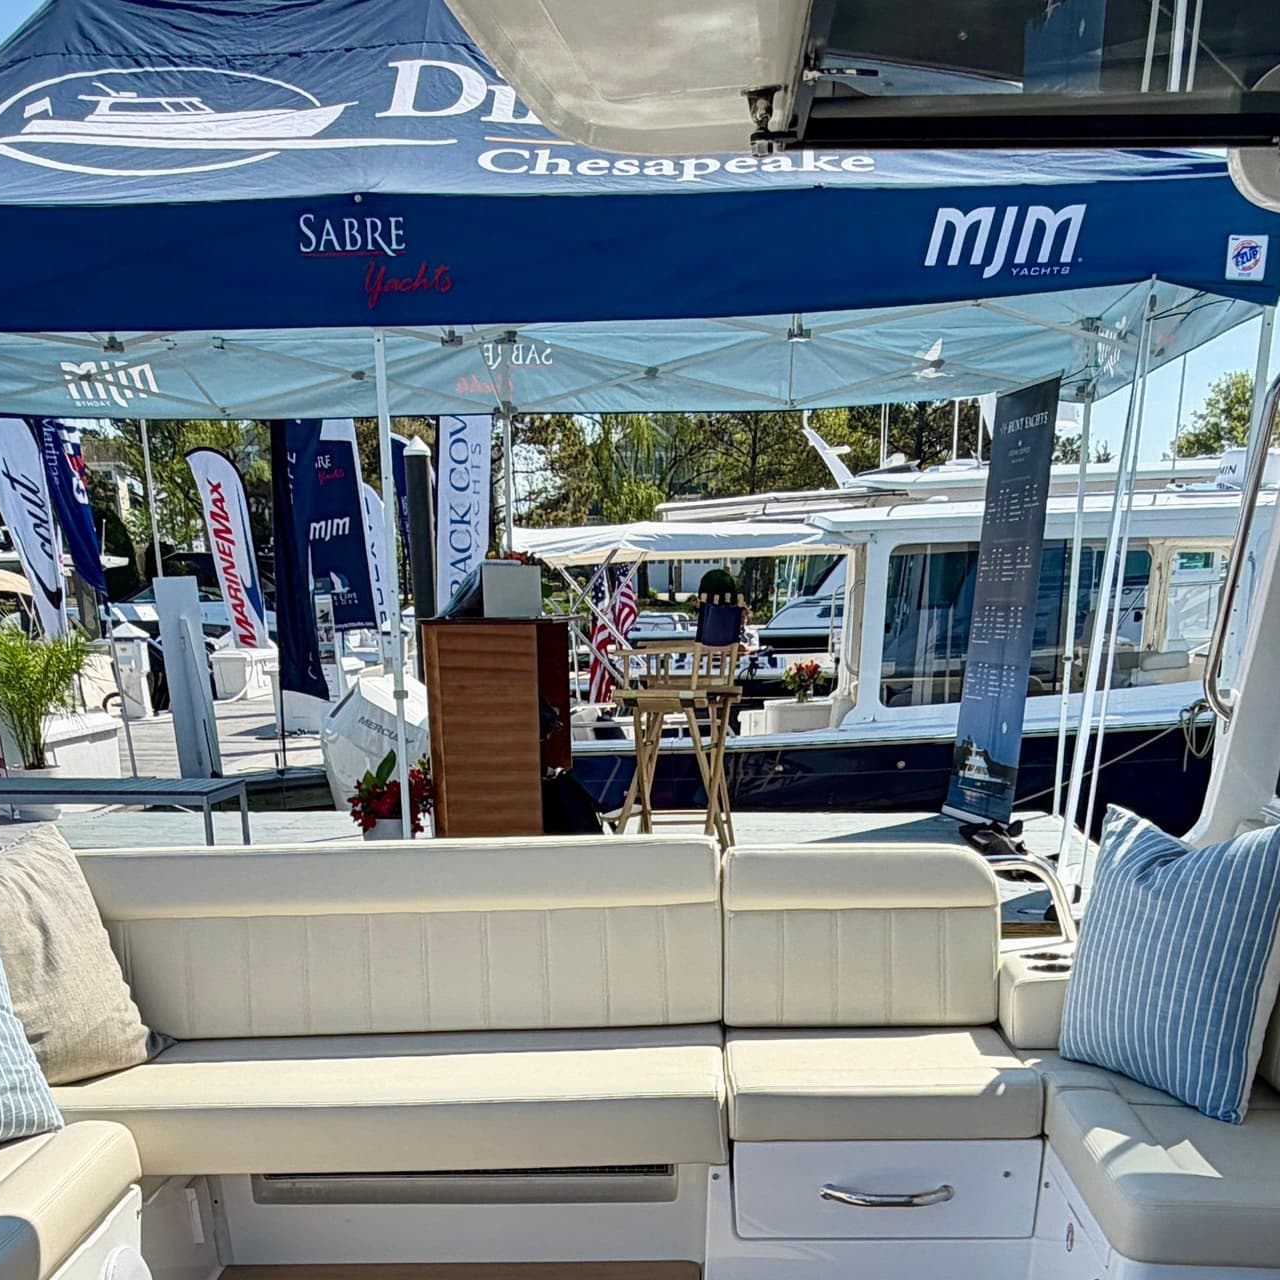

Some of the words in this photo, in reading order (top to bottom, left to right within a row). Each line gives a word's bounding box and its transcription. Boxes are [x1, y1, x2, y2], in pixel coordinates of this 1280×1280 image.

[477, 148, 876, 183] Chesapeake
[299, 213, 407, 257] SABRE
[365, 261, 452, 309] Yachts
[1011, 266, 1071, 276] YACHTS
[448, 415, 471, 492] COV
[358, 715, 416, 744] MERCUY
